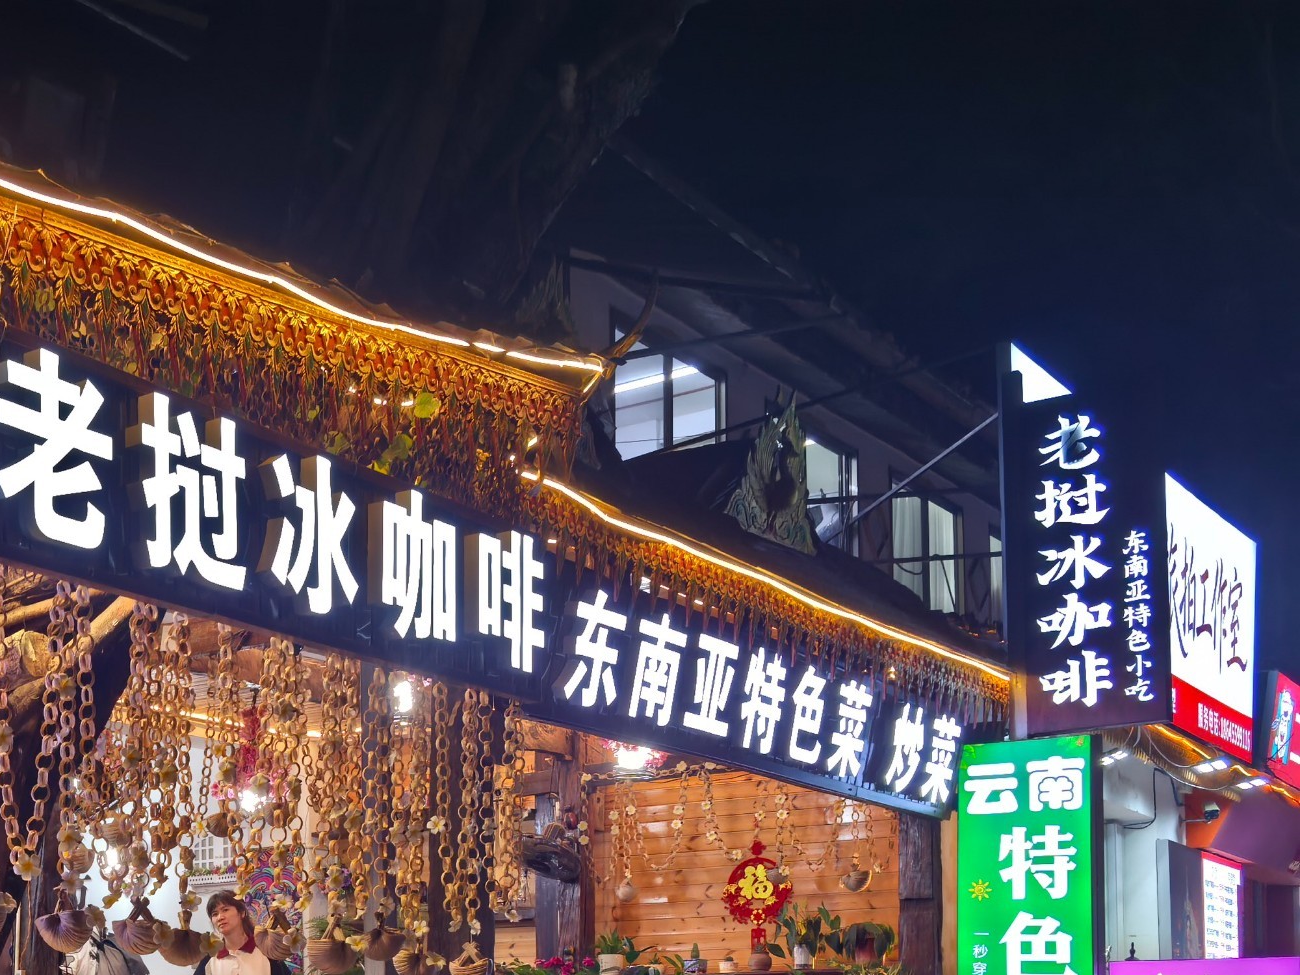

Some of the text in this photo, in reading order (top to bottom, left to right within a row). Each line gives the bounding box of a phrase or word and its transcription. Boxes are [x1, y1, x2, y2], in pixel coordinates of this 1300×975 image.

[1033, 413, 1114, 708] 老挝冰咖啡
[1122, 529, 1155, 703] 东南亚特色小吃
[563, 589, 875, 781] 东南亚特色菜
[884, 702, 967, 805] 炒菜
[964, 755, 1086, 815] 云南
